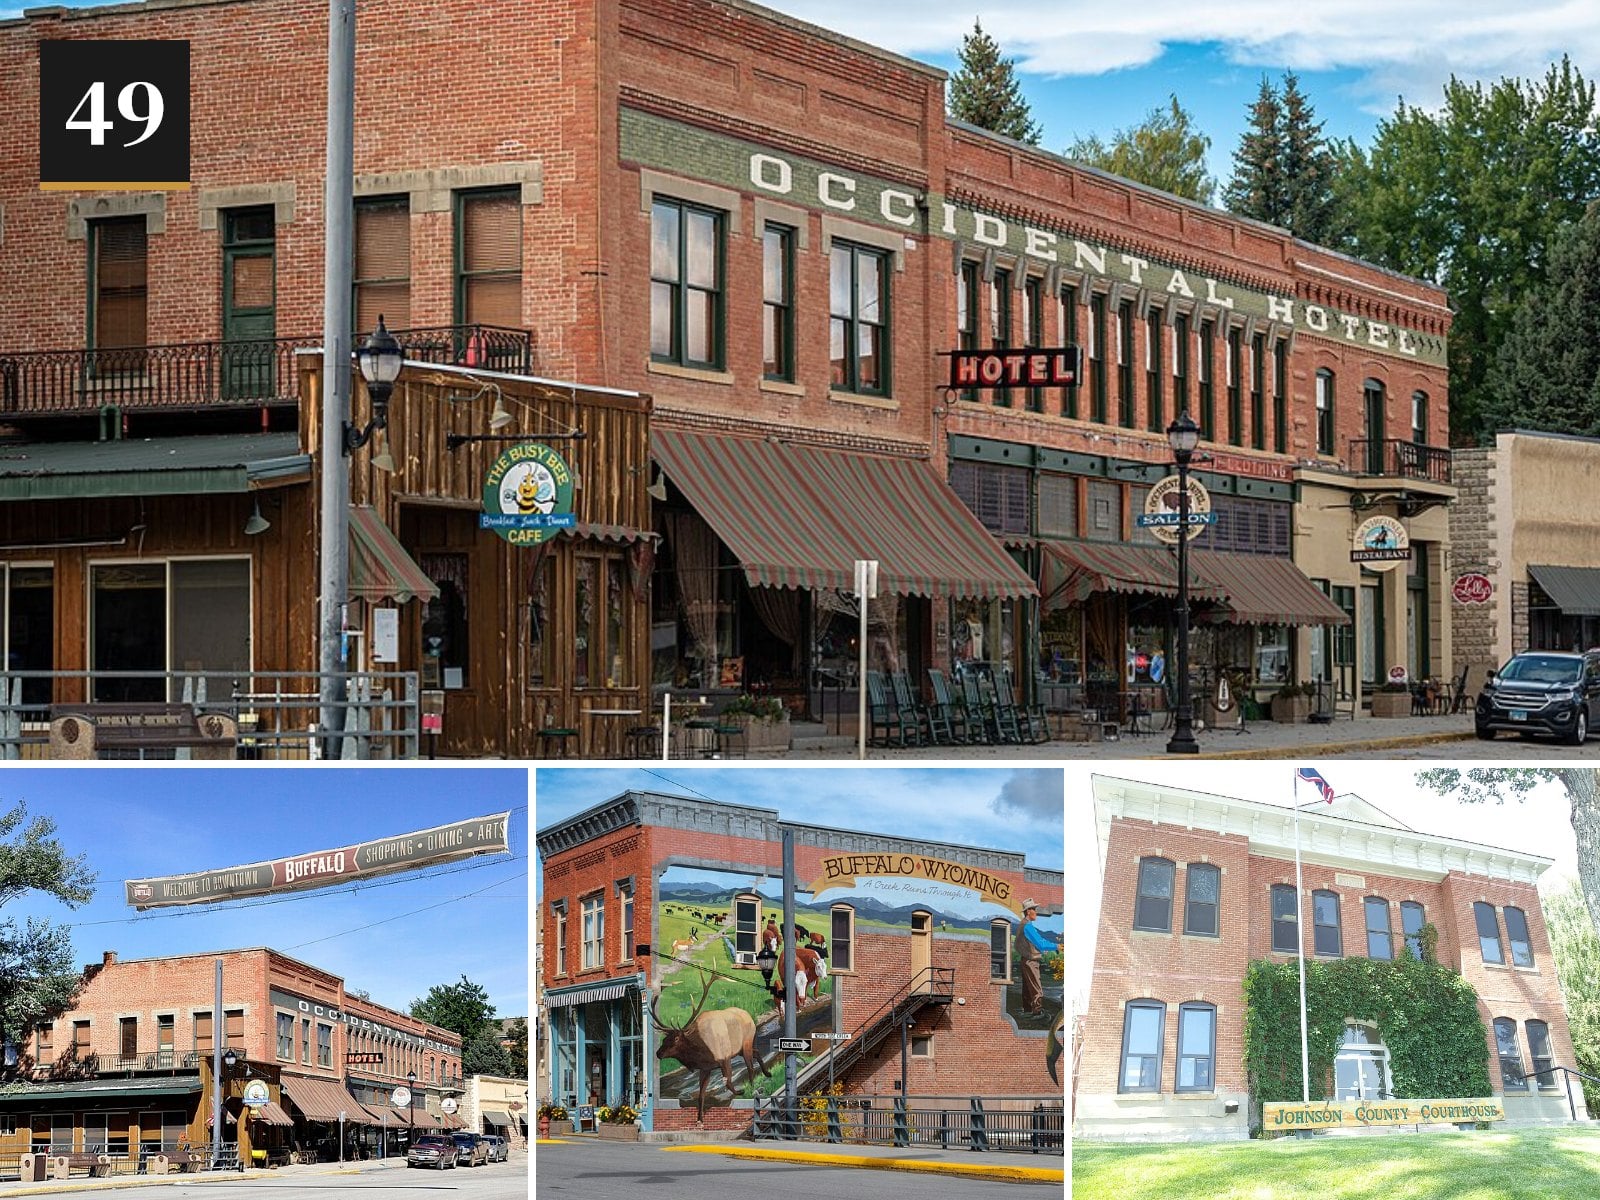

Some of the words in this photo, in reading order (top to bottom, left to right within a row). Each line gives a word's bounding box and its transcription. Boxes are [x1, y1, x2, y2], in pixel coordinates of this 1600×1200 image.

[750, 153, 1234, 309] OCCIDENTAL
[1267, 295, 1416, 356] HOTEL
[956, 354, 1075, 385] HOTEL
[487, 456, 509, 486] THE
[508, 445, 548, 461] BUSY
[546, 454, 569, 486] BEE
[508, 530, 542, 542] CAFE
[1353, 550, 1409, 560] RESTAURANT
[366, 839, 413, 863] SHOPPING
[427, 828, 463, 850] DINING
[478, 821, 505, 841] ARTS
[285, 851, 345, 883] BUFFALO
[824, 856, 915, 878] BUFFALO
[921, 858, 1010, 899] WYOMING
[163, 882, 199, 897] WELCOME
[202, 879, 211, 892] TO
[213, 870, 258, 890] DOWNTOWN
[863, 880, 873, 888] A
[874, 880, 900, 891] Creek
[902, 884, 927, 894] Runs
[928, 886, 962, 900] Through
[298, 1000, 411, 1042] OCCIDENTAL
[418, 1037, 454, 1054] HOTEL
[348, 1054, 382, 1063] HOTEL
[1275, 1108, 1342, 1125] JOHNSON
[1355, 1106, 1410, 1121] COUNTY
[1420, 1105, 1499, 1119] COURTHOUSE
